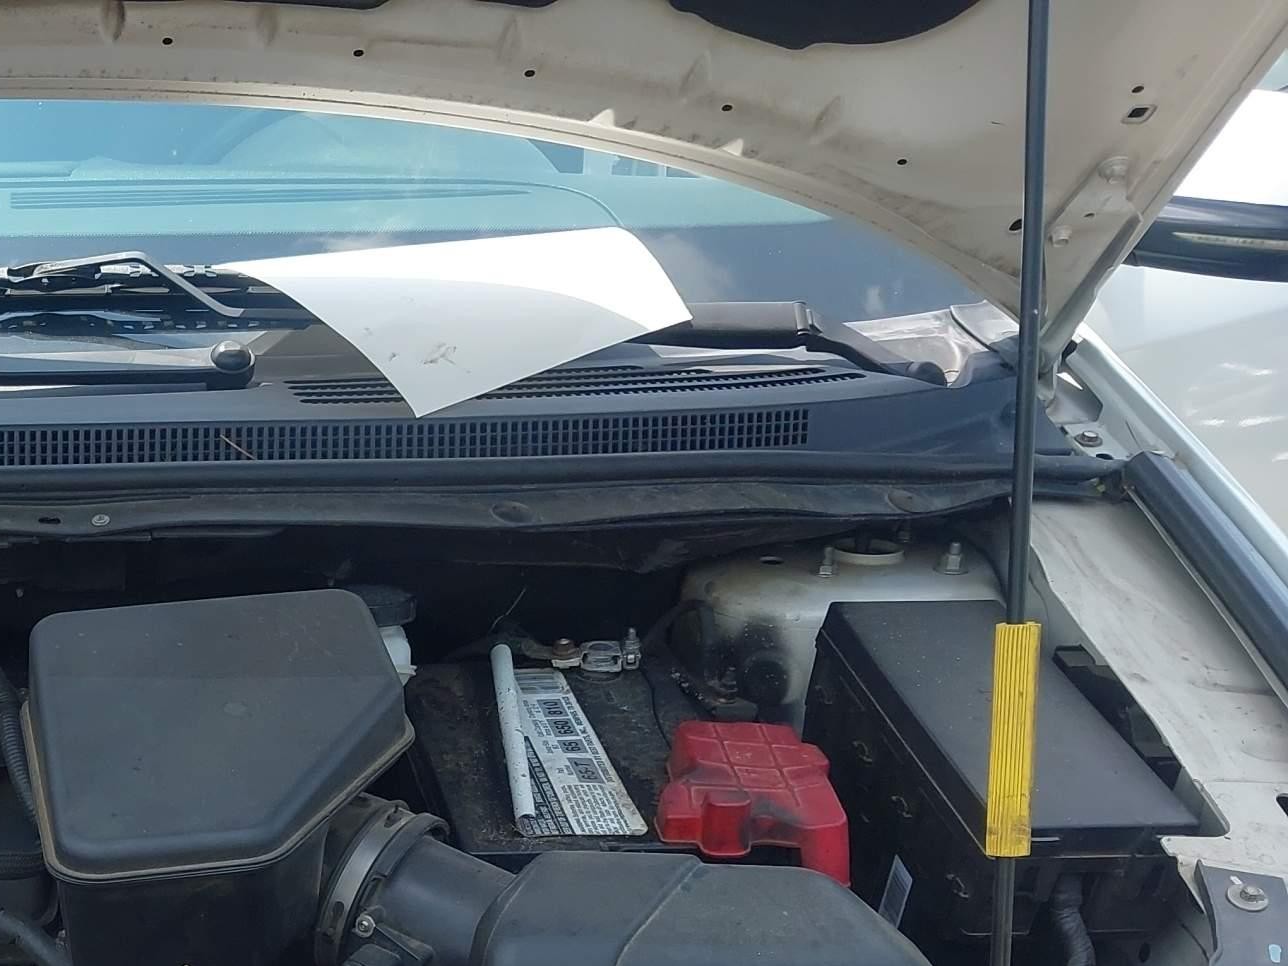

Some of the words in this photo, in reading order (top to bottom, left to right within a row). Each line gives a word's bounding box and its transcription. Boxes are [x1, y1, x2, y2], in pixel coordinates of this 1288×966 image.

[543, 701, 563, 715] 810
[553, 720, 574, 735] 650
[563, 741, 581, 752] 65
